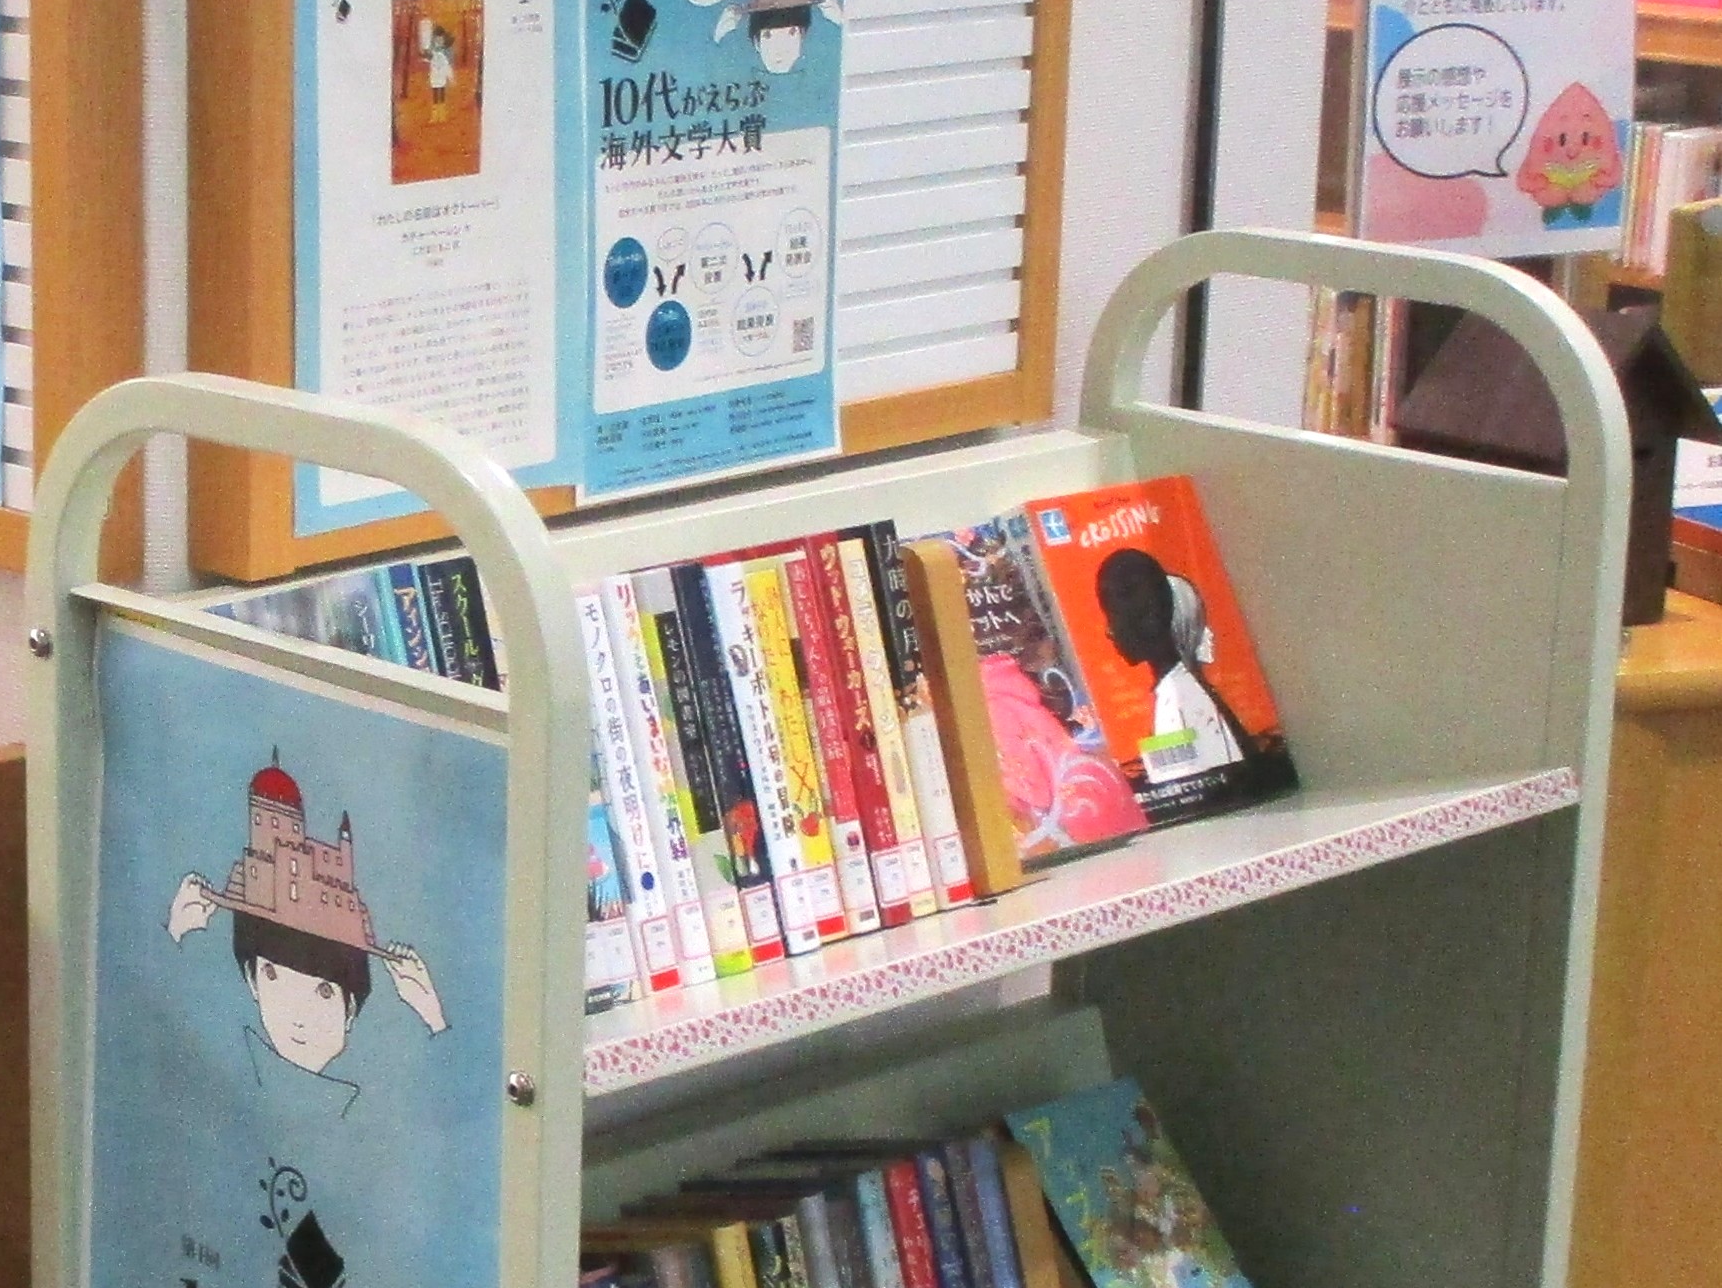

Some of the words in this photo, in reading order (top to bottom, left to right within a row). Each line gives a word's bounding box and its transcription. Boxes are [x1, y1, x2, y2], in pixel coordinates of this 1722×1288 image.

[599, 71, 770, 128] 10代がえらぶ
[600, 114, 767, 171] 海外文学大賞
